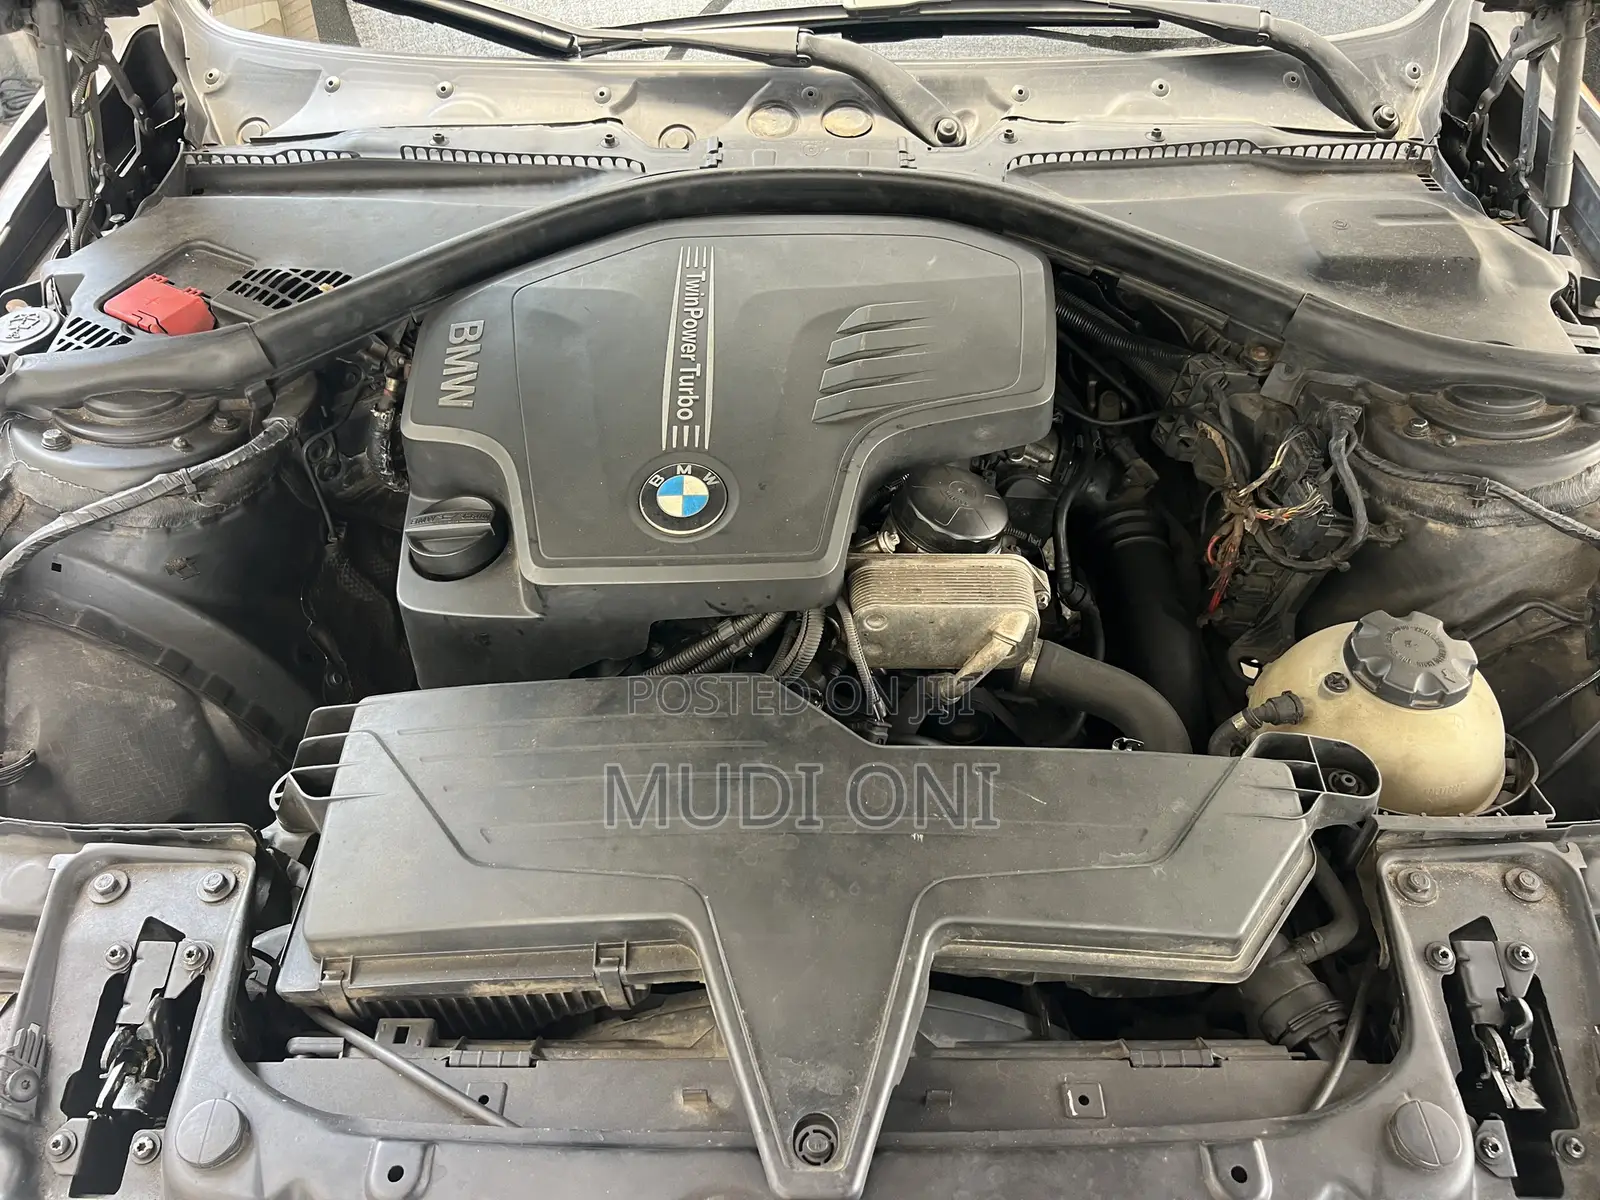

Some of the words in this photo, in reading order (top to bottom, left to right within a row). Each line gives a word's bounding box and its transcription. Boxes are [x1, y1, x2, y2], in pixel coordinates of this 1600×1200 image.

[682, 270, 706, 361] TwinPower
[438, 320, 485, 407] BMW
[676, 363, 702, 421] Turbo
[648, 464, 720, 488] BMW
